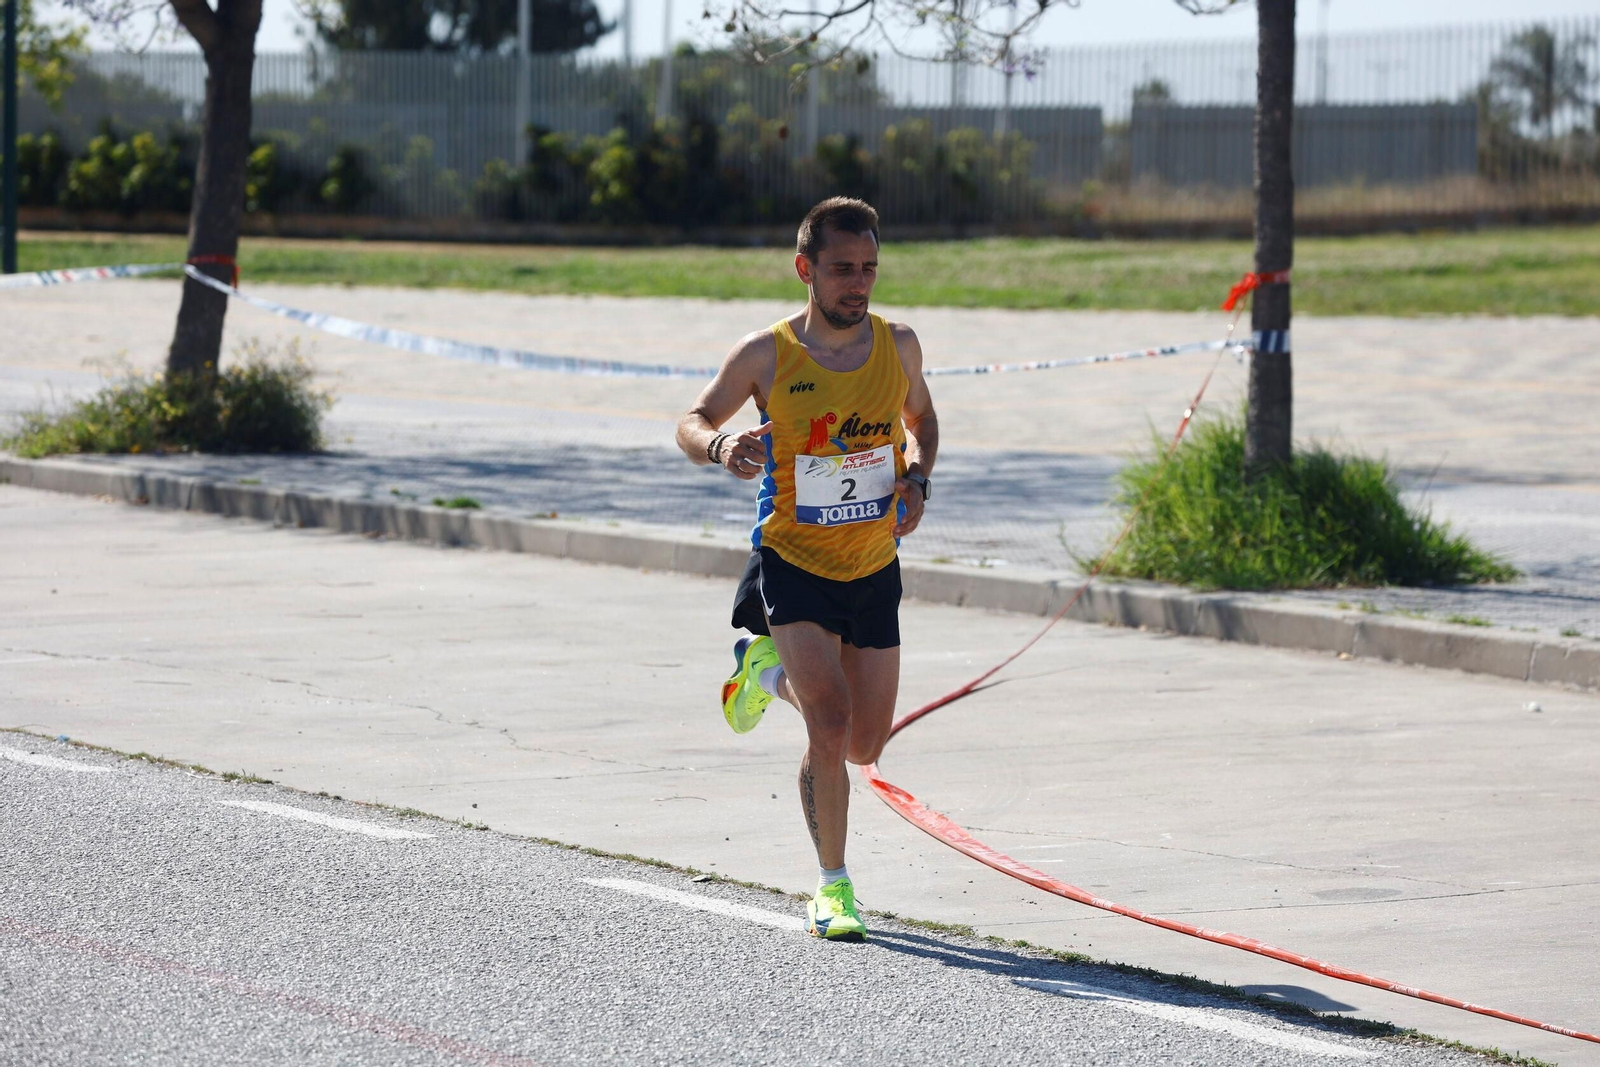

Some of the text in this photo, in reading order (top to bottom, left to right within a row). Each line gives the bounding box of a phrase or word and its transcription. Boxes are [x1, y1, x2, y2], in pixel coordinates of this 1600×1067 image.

[790, 381, 815, 394] vive
[838, 412, 892, 438] Álora
[841, 478, 857, 501] 2
[817, 501, 881, 525] Joma
